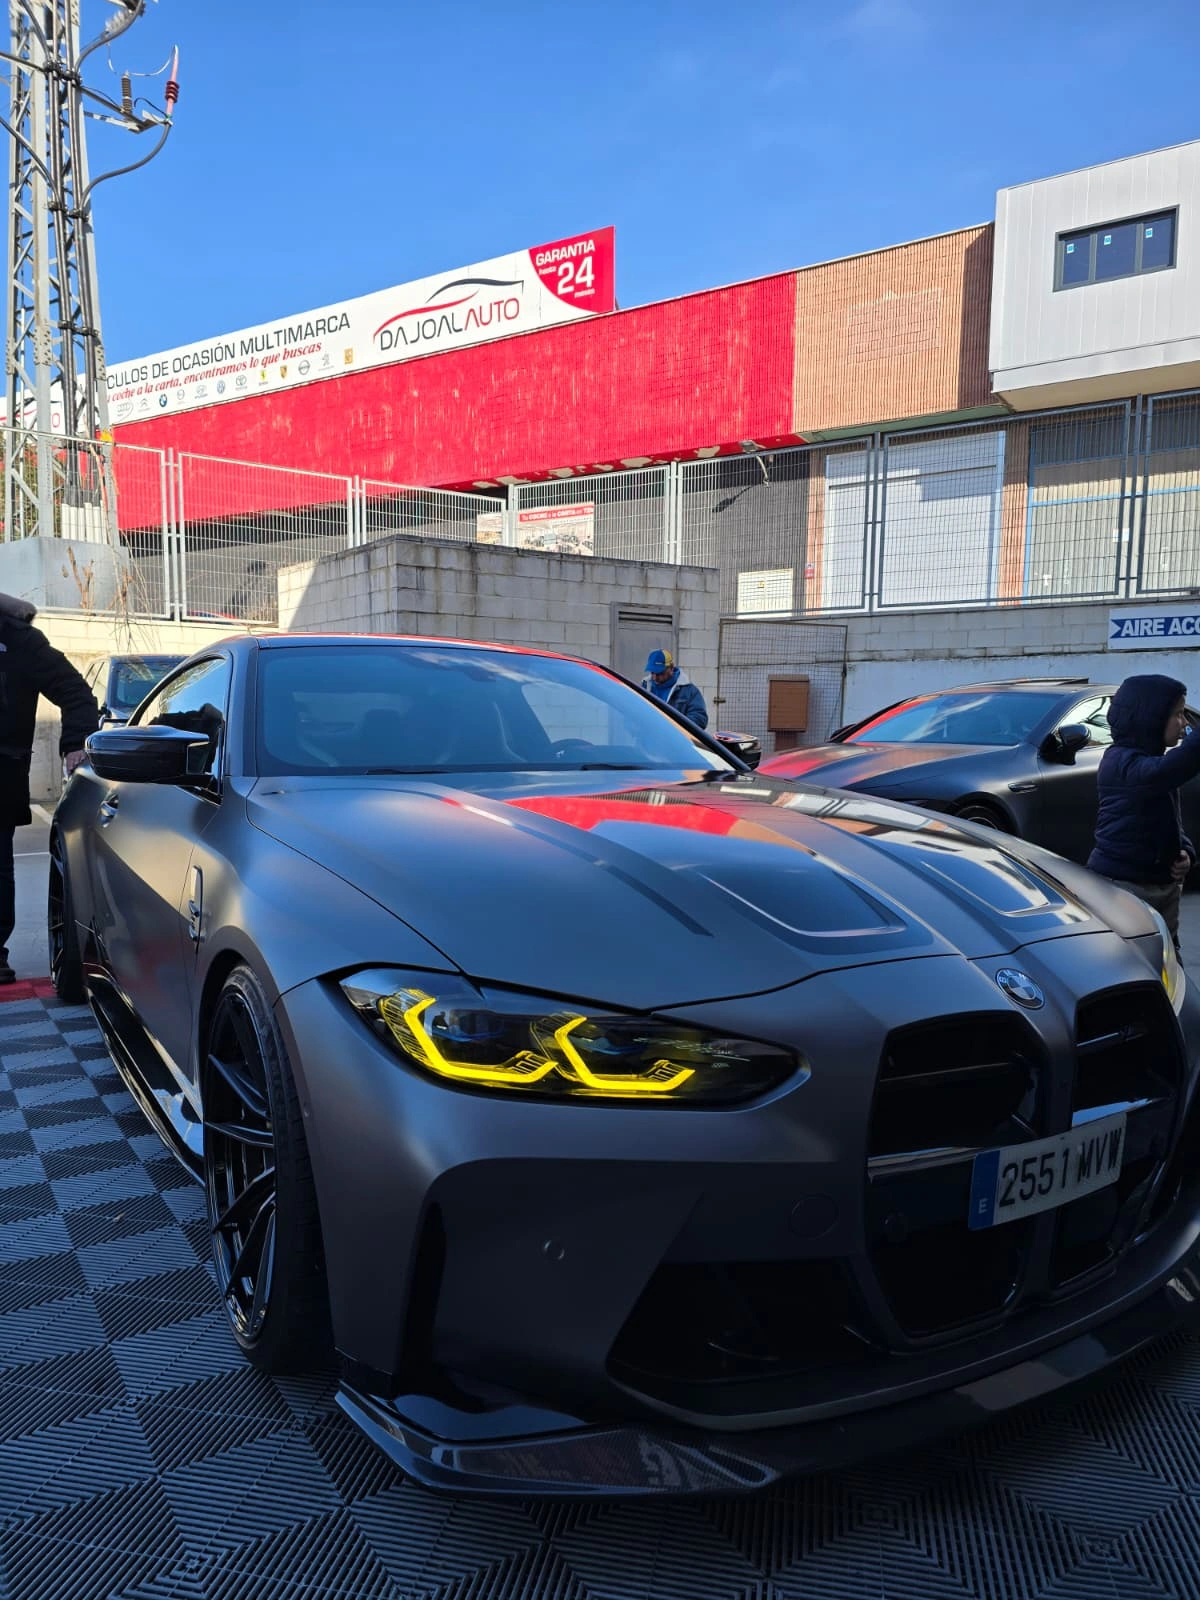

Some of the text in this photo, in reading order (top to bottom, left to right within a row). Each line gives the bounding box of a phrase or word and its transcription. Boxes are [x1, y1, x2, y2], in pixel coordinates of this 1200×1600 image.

[536, 240, 595, 266] GARANTIA
[557, 256, 595, 295] 24
[107, 312, 351, 390] CULOS DE OCASIÓN MULTIMARCA
[112, 388, 135, 402] coche
[136, 386, 143, 395] a
[144, 382, 153, 393] la
[183, 361, 247, 385] encontramos
[249, 356, 260, 369] lo
[261, 353, 281, 369] que
[282, 342, 322, 360] buscas
[1120, 618, 1165, 637] AIRE
[999, 1127, 1122, 1208] 2551 MVW
[978, 1198, 988, 1214] E
